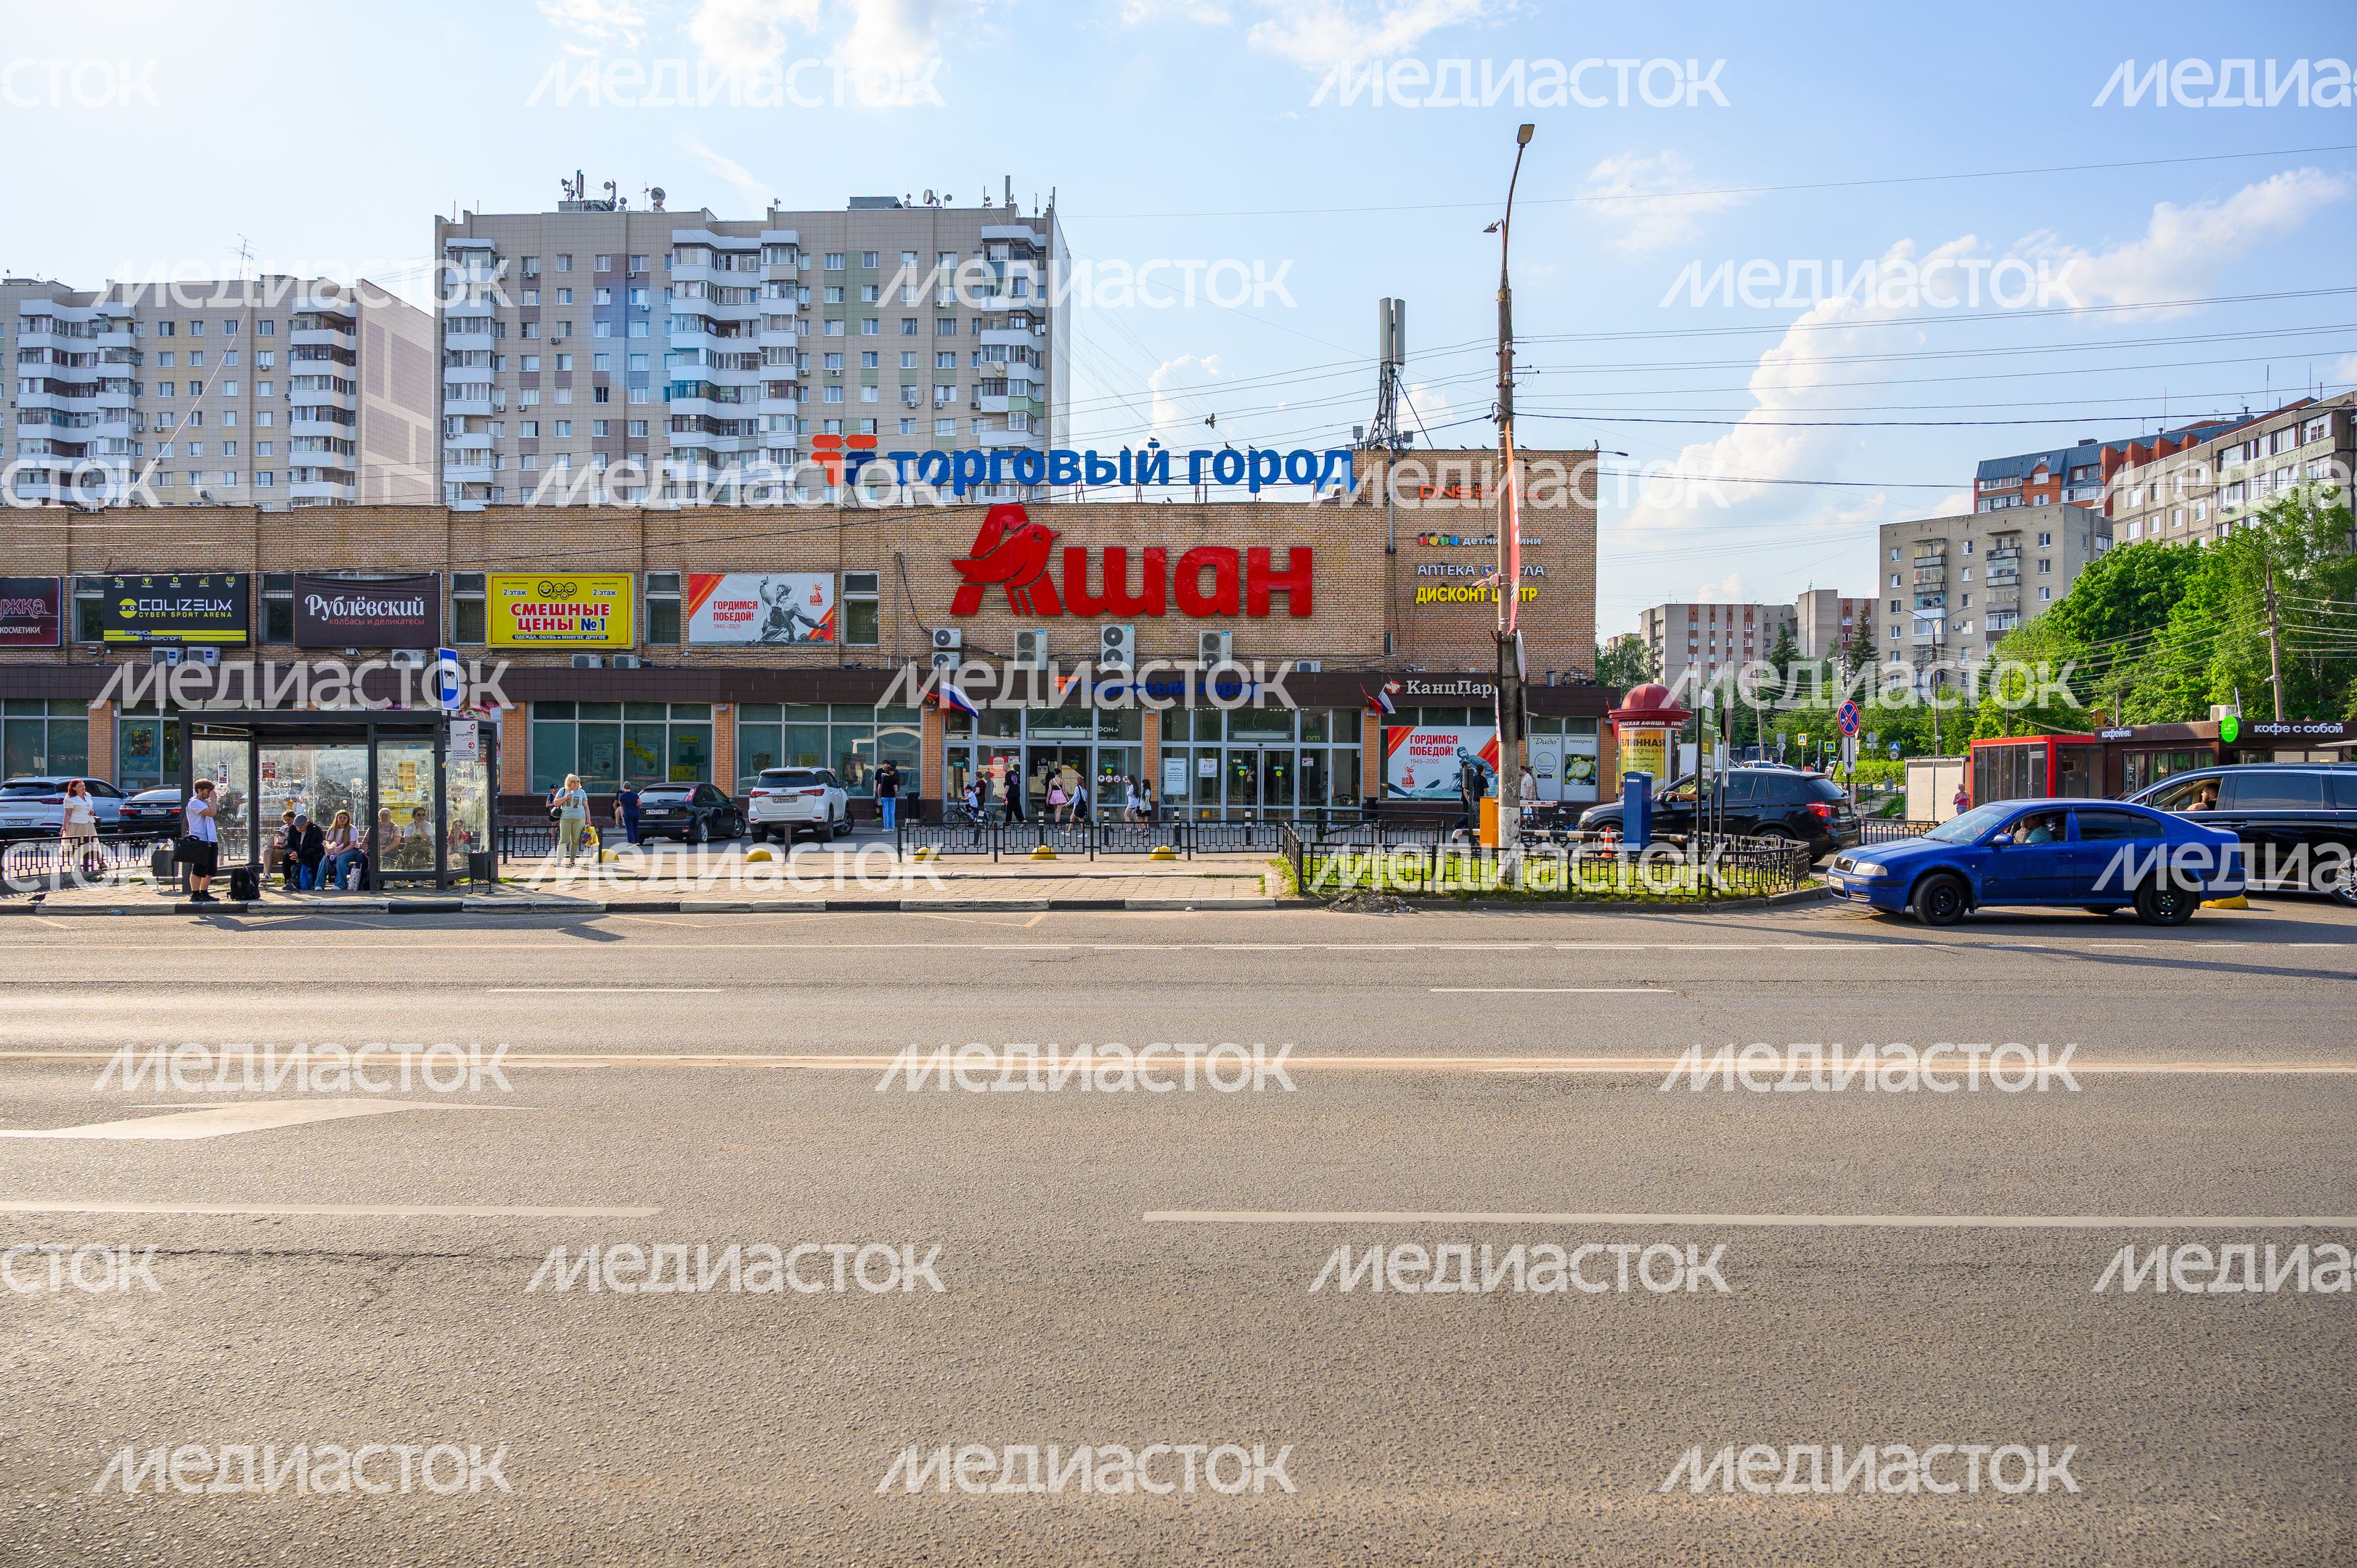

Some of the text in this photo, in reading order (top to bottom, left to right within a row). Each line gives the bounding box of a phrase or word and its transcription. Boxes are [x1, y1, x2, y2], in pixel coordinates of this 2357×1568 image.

[888, 441, 1357, 496] торговый город
[1420, 485, 1473, 499] DNS
[949, 504, 1312, 616] Ашан
[1417, 565, 1475, 576] АПТЕКА
[1416, 587, 1487, 604] ДИСКОНТ
[139, 599, 232, 611] COLIZEUM
[305, 594, 425, 621] Рублёвский
[510, 603, 610, 616] СМЕШНЫЕ
[713, 601, 758, 611] ГОРДИМСЯ
[713, 611, 754, 622] ПОБЕДОЙ!
[518, 618, 573, 632] ЦЕНЫ
[2254, 722, 2343, 735] кофе с собой
[1410, 735, 1458, 746] ГОРДИМСЯ
[1410, 746, 1454, 756] ПОБЕДОЙ!
